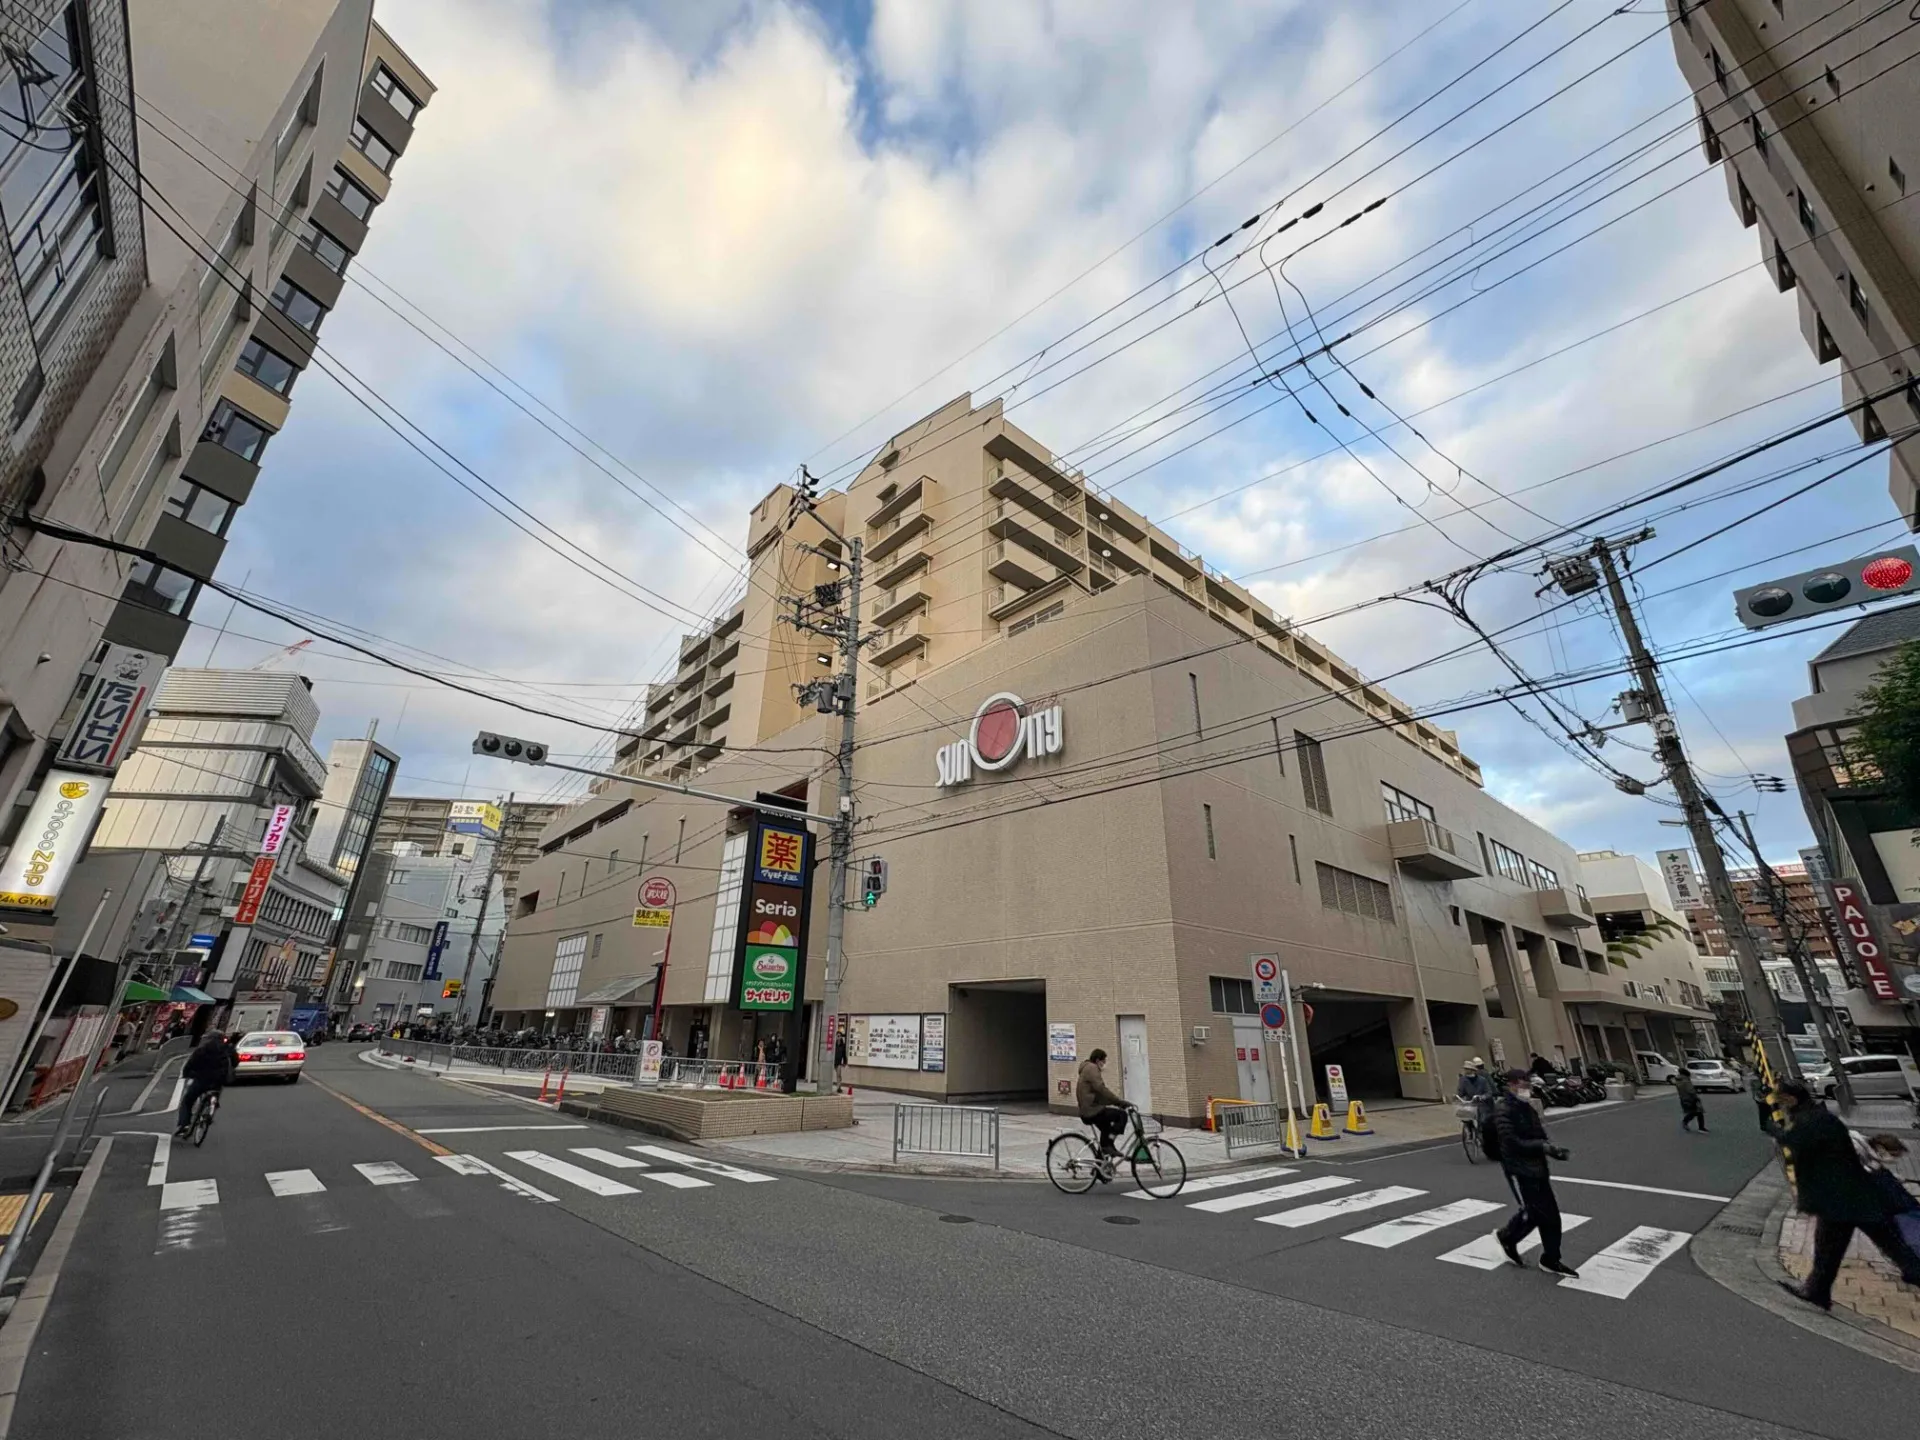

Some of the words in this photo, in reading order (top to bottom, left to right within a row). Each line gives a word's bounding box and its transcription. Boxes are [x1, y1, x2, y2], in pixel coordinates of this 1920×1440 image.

[74, 681, 138, 763] たいせい
[23, 800, 75, 887] chocoZAP
[265, 807, 290, 852] ジャンカラ
[766, 832, 798, 870] 薬
[0, 893, 15, 904] 4h
[18, 895, 48, 906] GYM
[755, 899, 797, 917] Seria
[1834, 887, 1894, 996] PAUOLE
[745, 988, 791, 1004] サイゼリヤ
